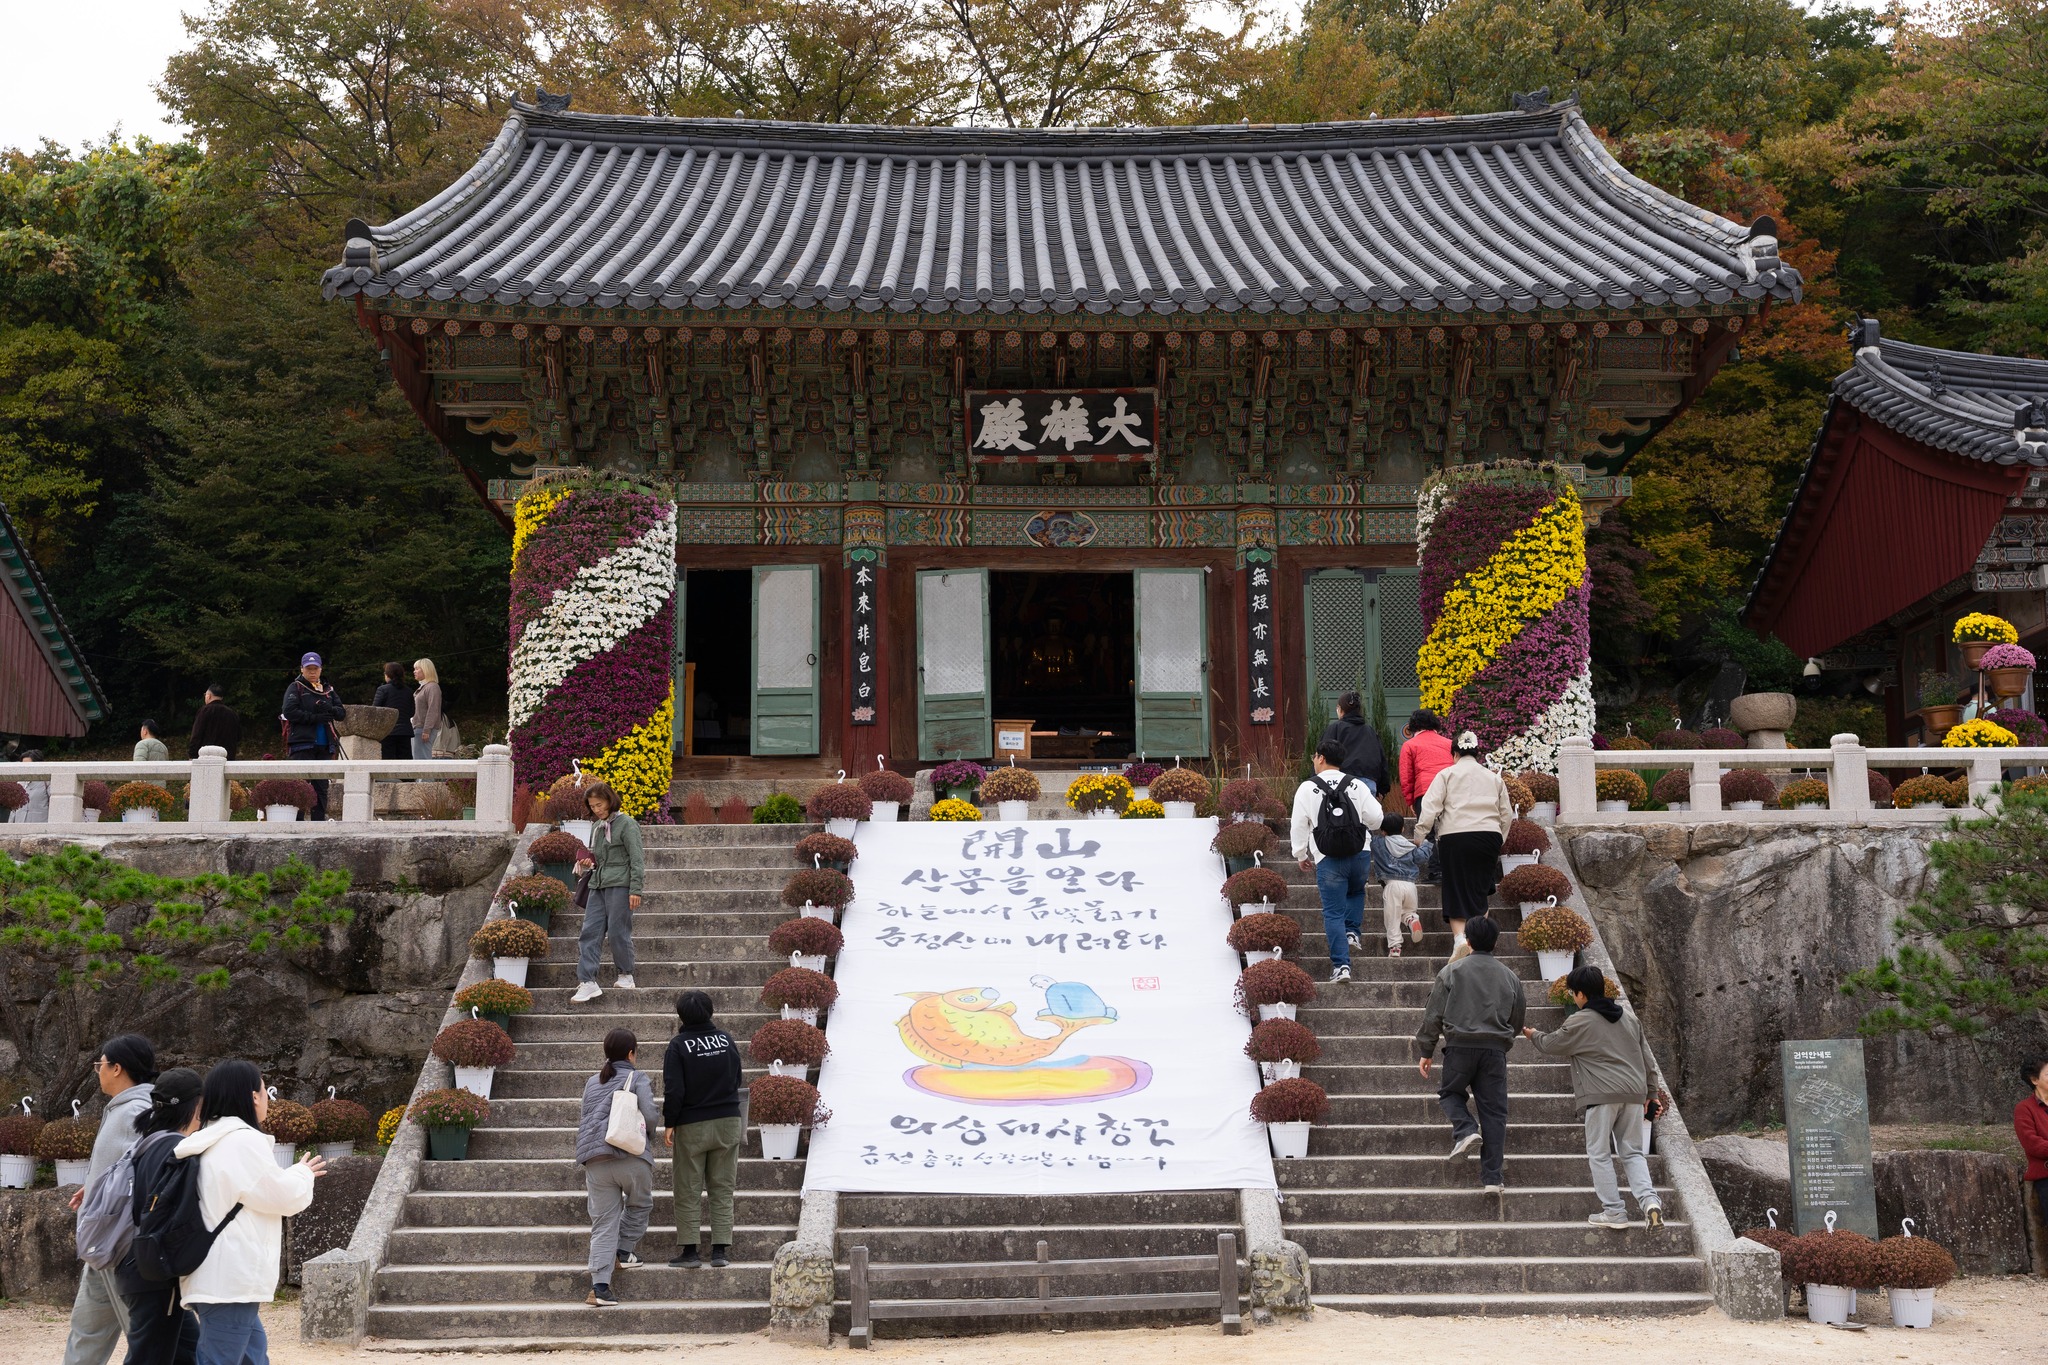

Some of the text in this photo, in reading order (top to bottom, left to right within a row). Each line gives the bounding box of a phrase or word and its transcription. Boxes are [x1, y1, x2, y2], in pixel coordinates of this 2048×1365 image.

[973, 396, 1152, 452] 大雄殿
[1251, 567, 1270, 698] 無短亦無長
[962, 826, 1102, 860] 開山
[901, 865, 1145, 895] 산문을 열다
[877, 901, 1013, 921] 하늘에서
[875, 926, 1168, 954] 금정산에 내려온다
[684, 1034, 729, 1053] PARIS
[1793, 1051, 1832, 1060] 권역안내도
